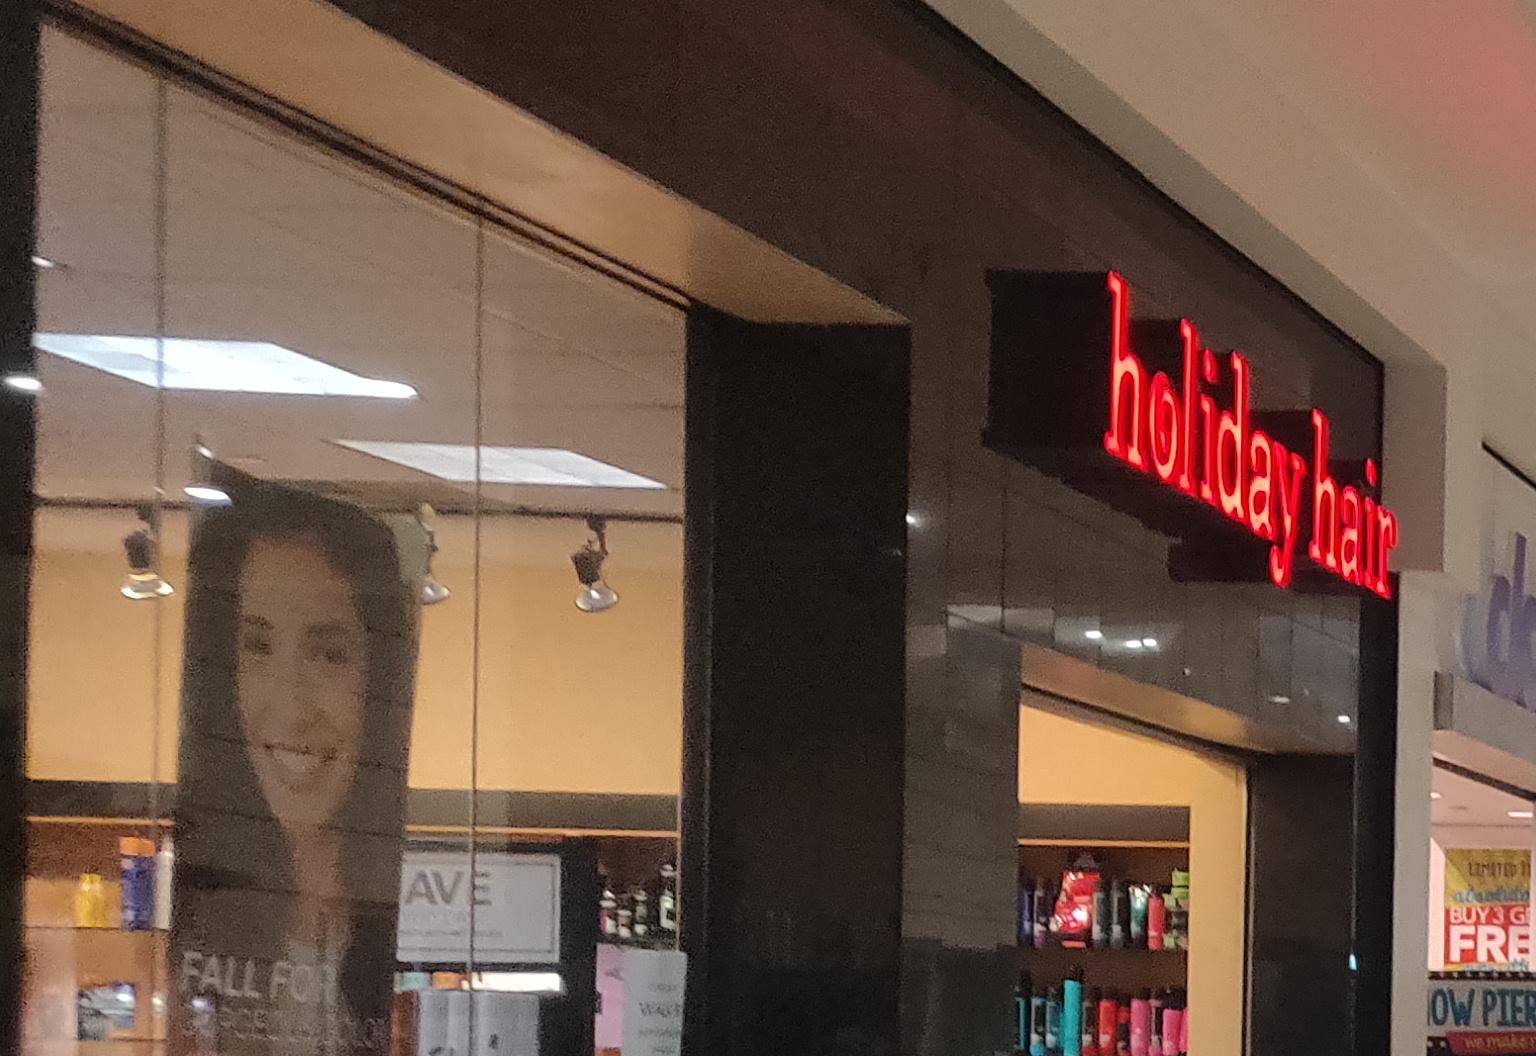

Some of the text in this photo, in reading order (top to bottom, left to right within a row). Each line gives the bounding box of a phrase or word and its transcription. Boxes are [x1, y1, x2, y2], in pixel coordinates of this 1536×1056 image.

[1104, 270, 1398, 599] holiday hair
[403, 868, 492, 905] AVE
[1449, 906, 1489, 925] BUY
[1493, 907, 1504, 925] 3
[1449, 924, 1530, 963] FRE
[180, 951, 259, 998] FALL
[1428, 987, 1475, 1027] OW
